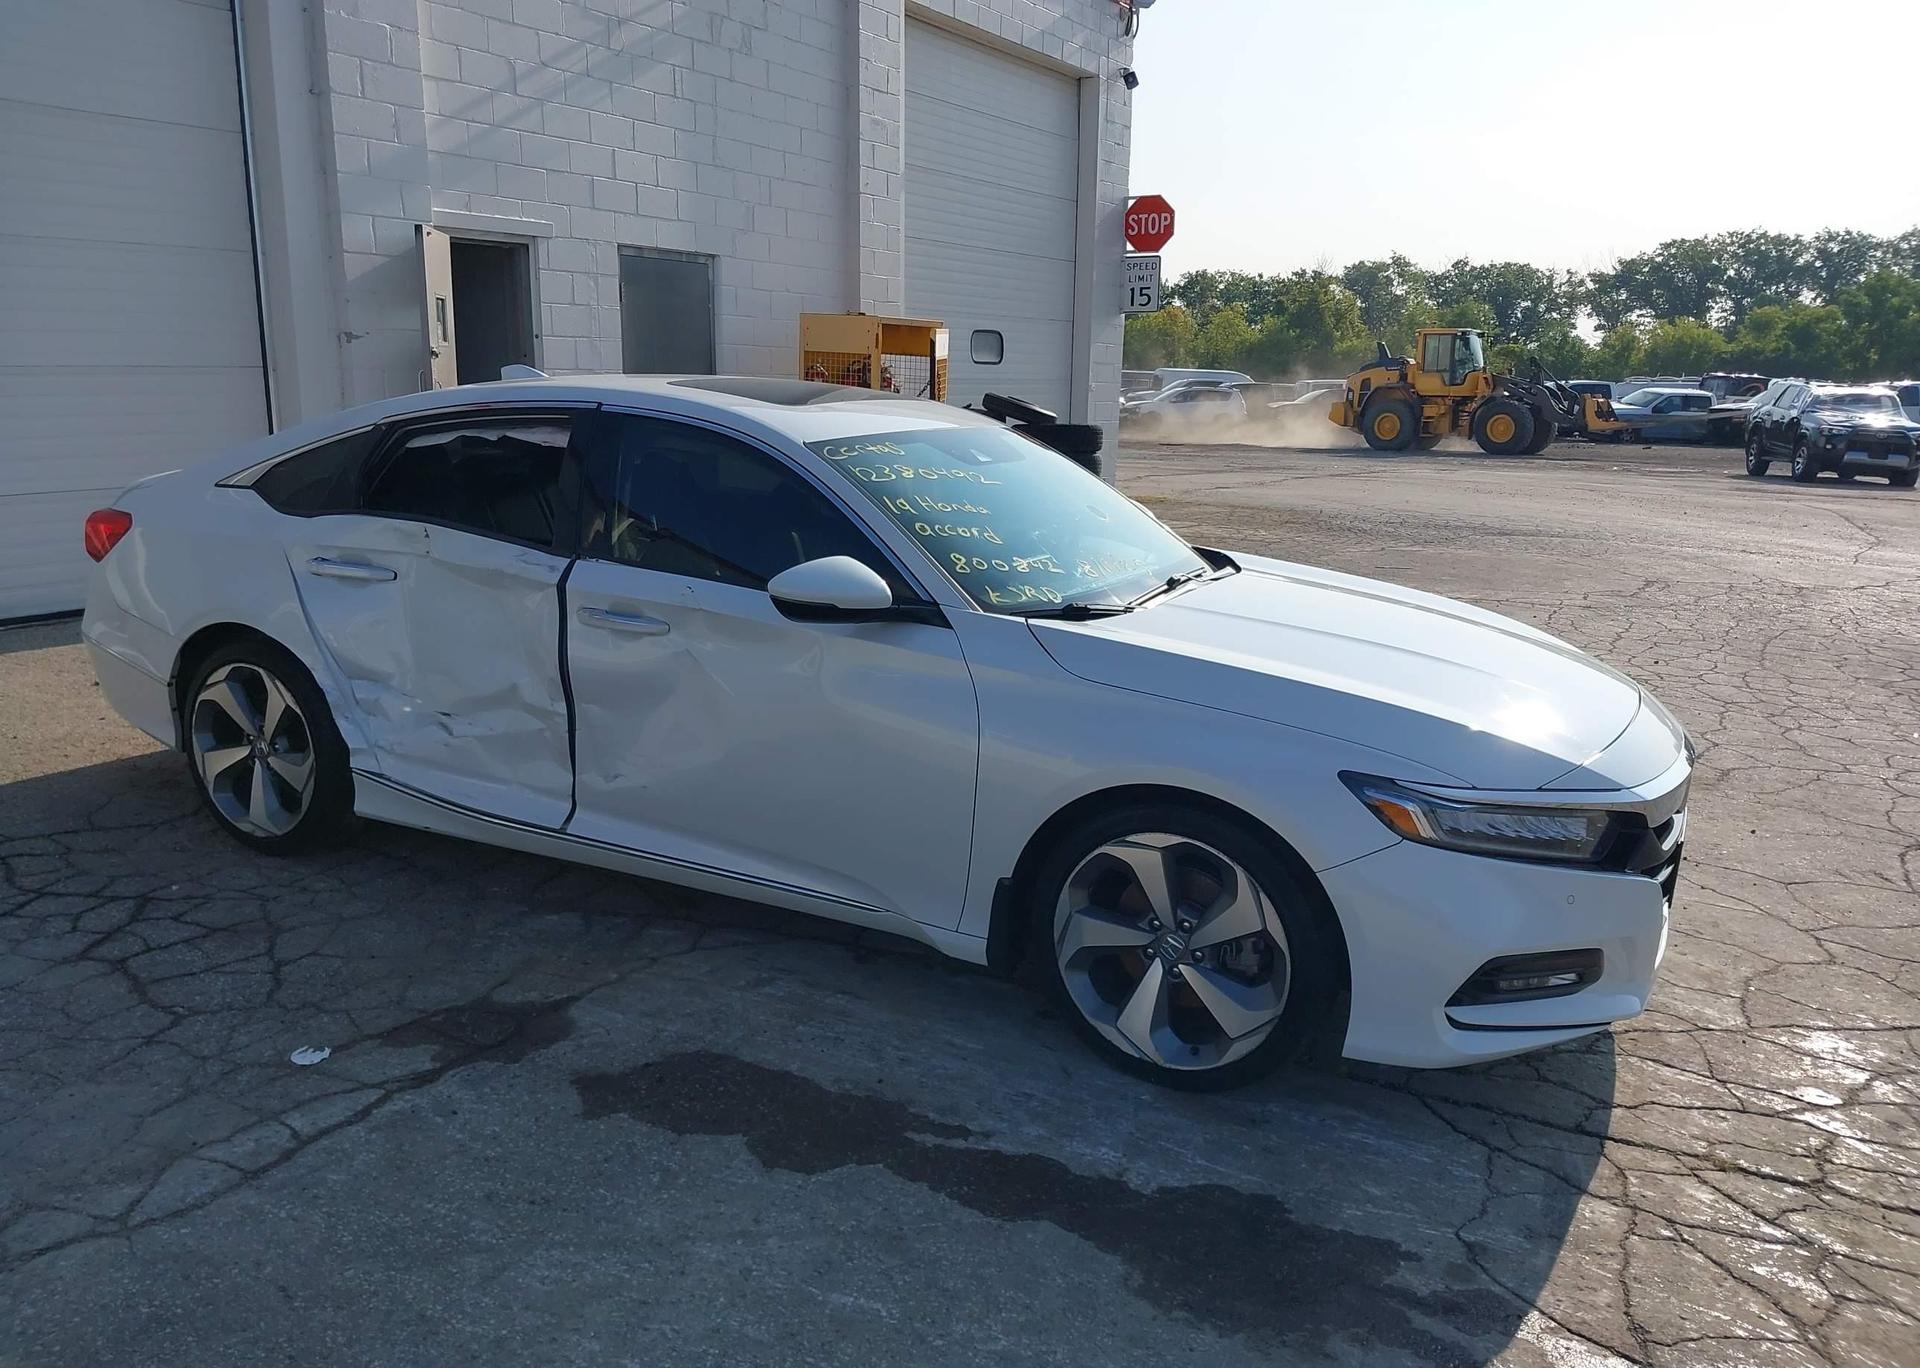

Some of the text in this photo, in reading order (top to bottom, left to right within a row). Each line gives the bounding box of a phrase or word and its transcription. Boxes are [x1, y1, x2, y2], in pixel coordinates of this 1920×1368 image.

[1128, 212, 1171, 235] STOP
[1126, 262, 1158, 271] SPEED
[1128, 274, 1154, 283] LIMIT
[1129, 286, 1152, 307] 15
[883, 495, 992, 515] 19 Honda
